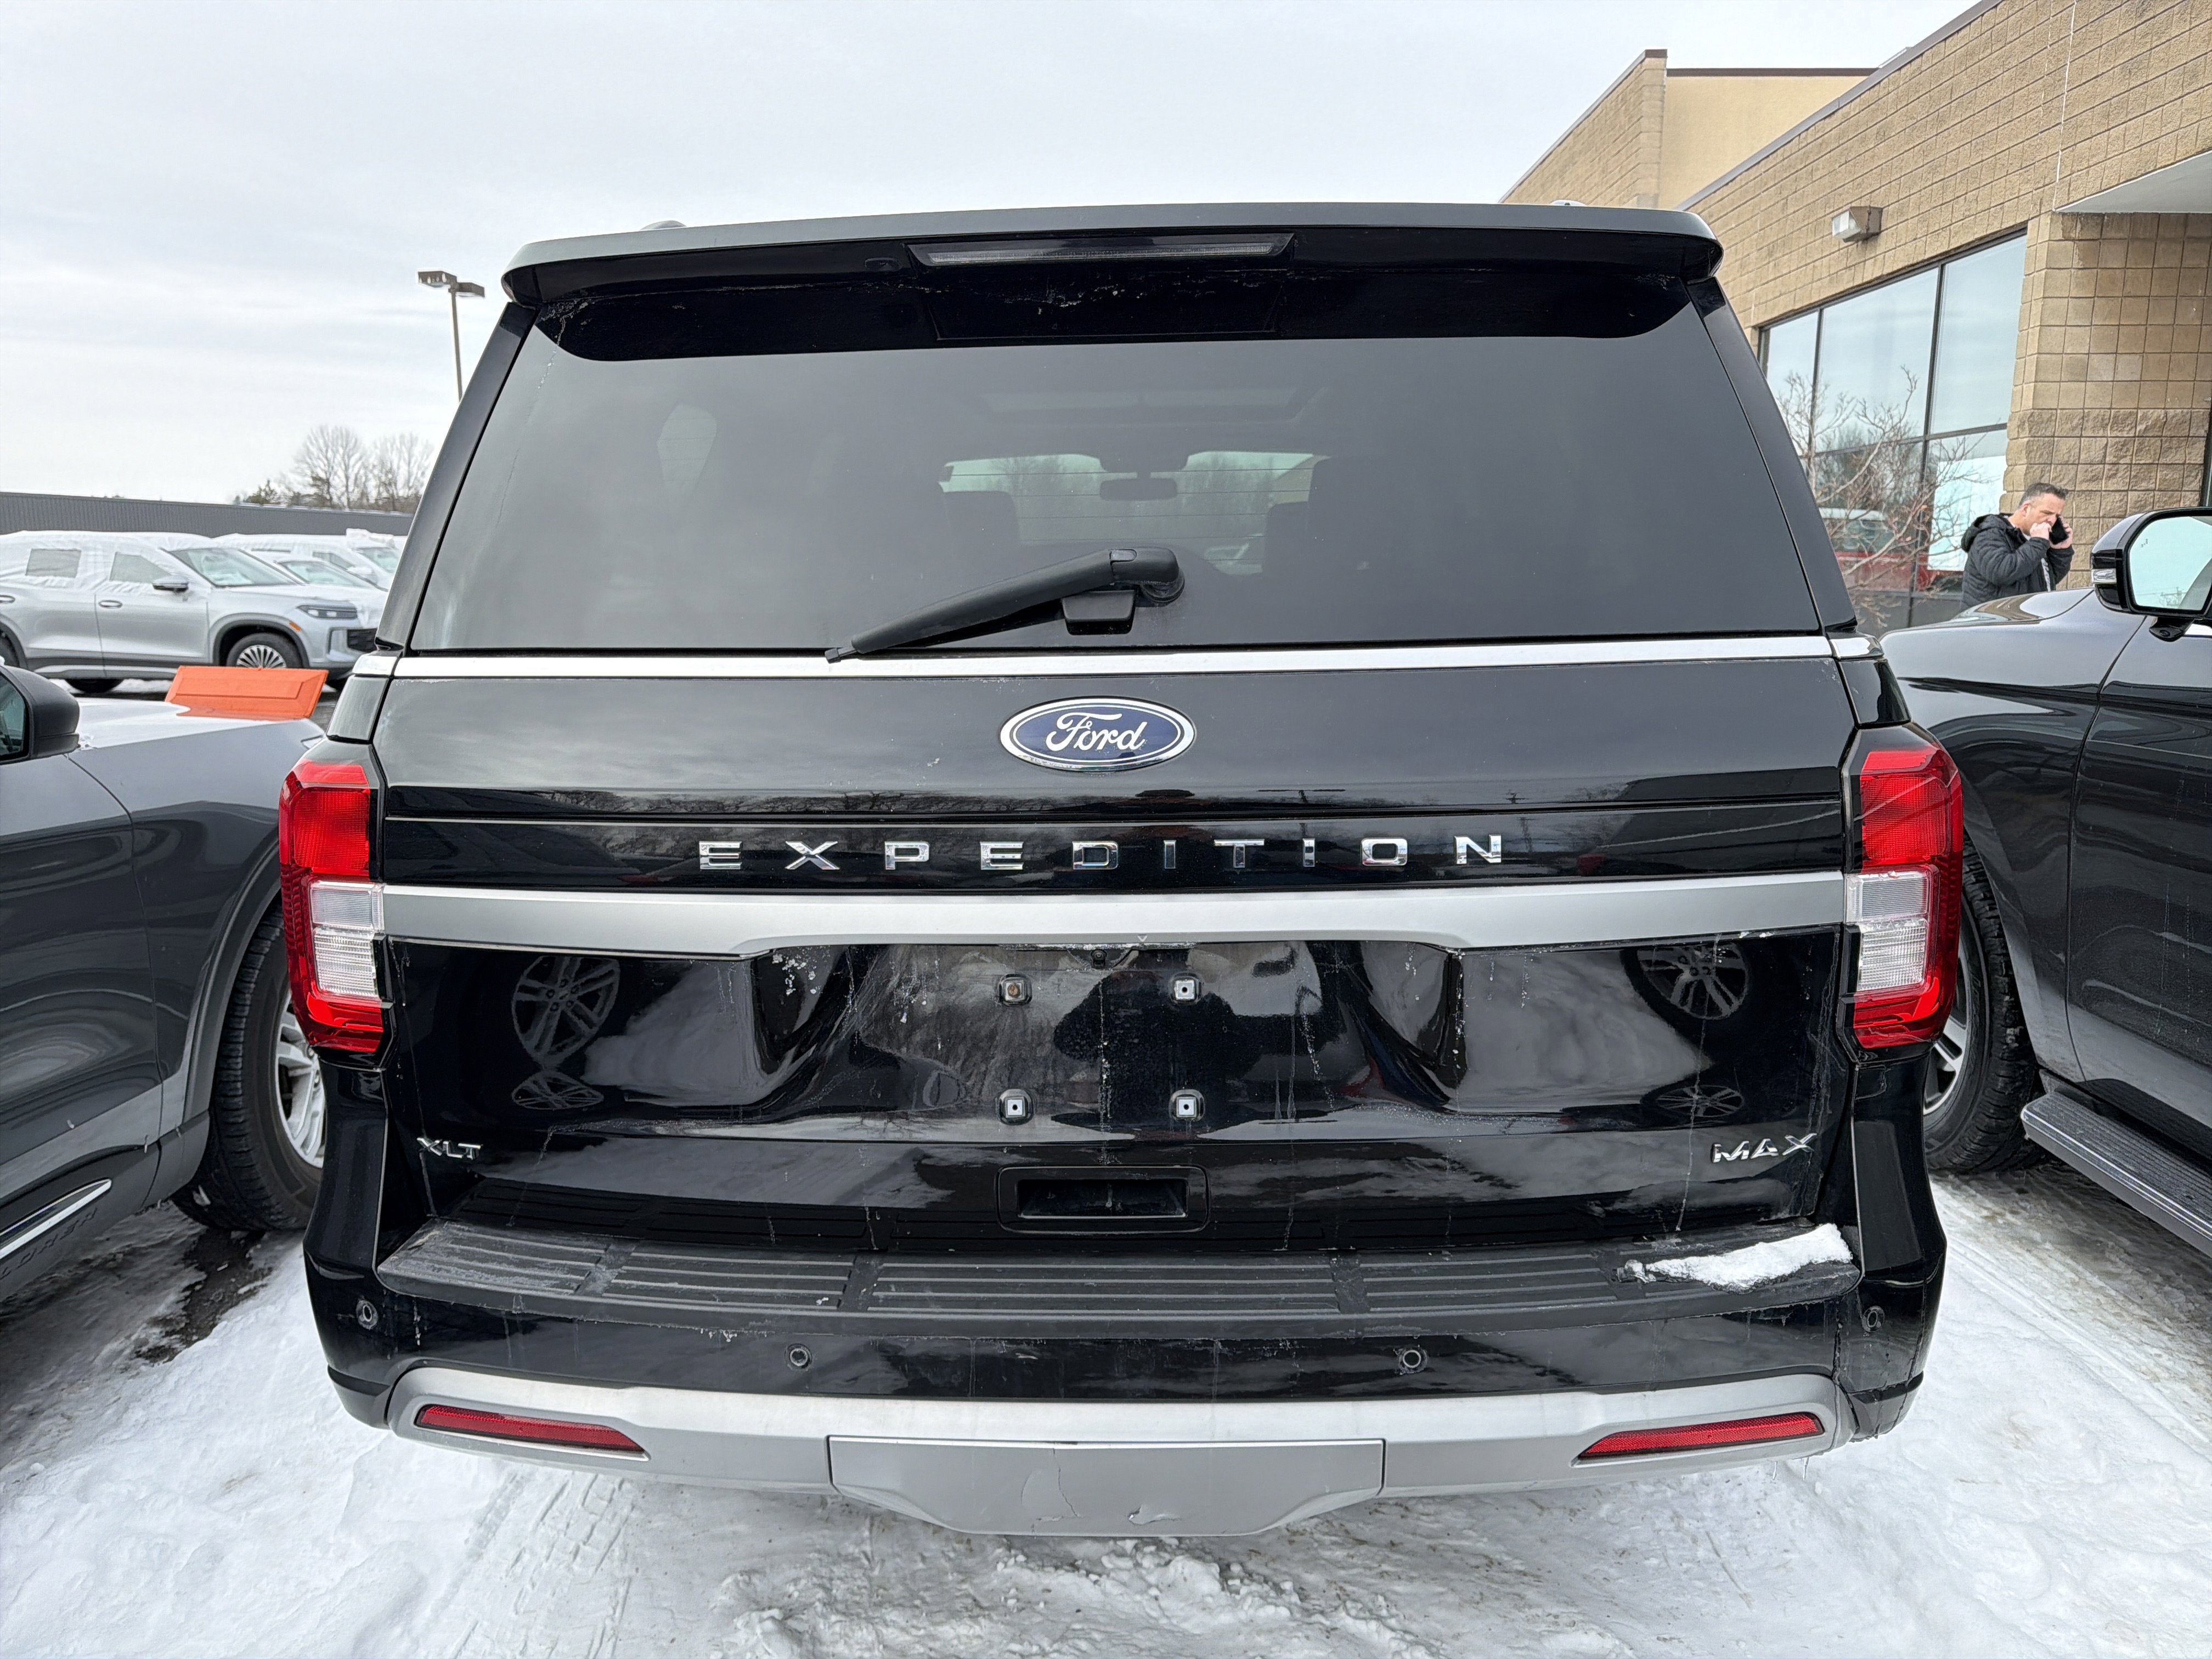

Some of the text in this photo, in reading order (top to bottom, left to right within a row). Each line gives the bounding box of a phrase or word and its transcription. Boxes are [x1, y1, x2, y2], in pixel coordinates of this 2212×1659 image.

[1046, 712, 1148, 751] Ford
[699, 834, 1502, 870] EXPEDITION
[416, 1137, 483, 1160] XLT
[1711, 1132, 1818, 1163] MAX
